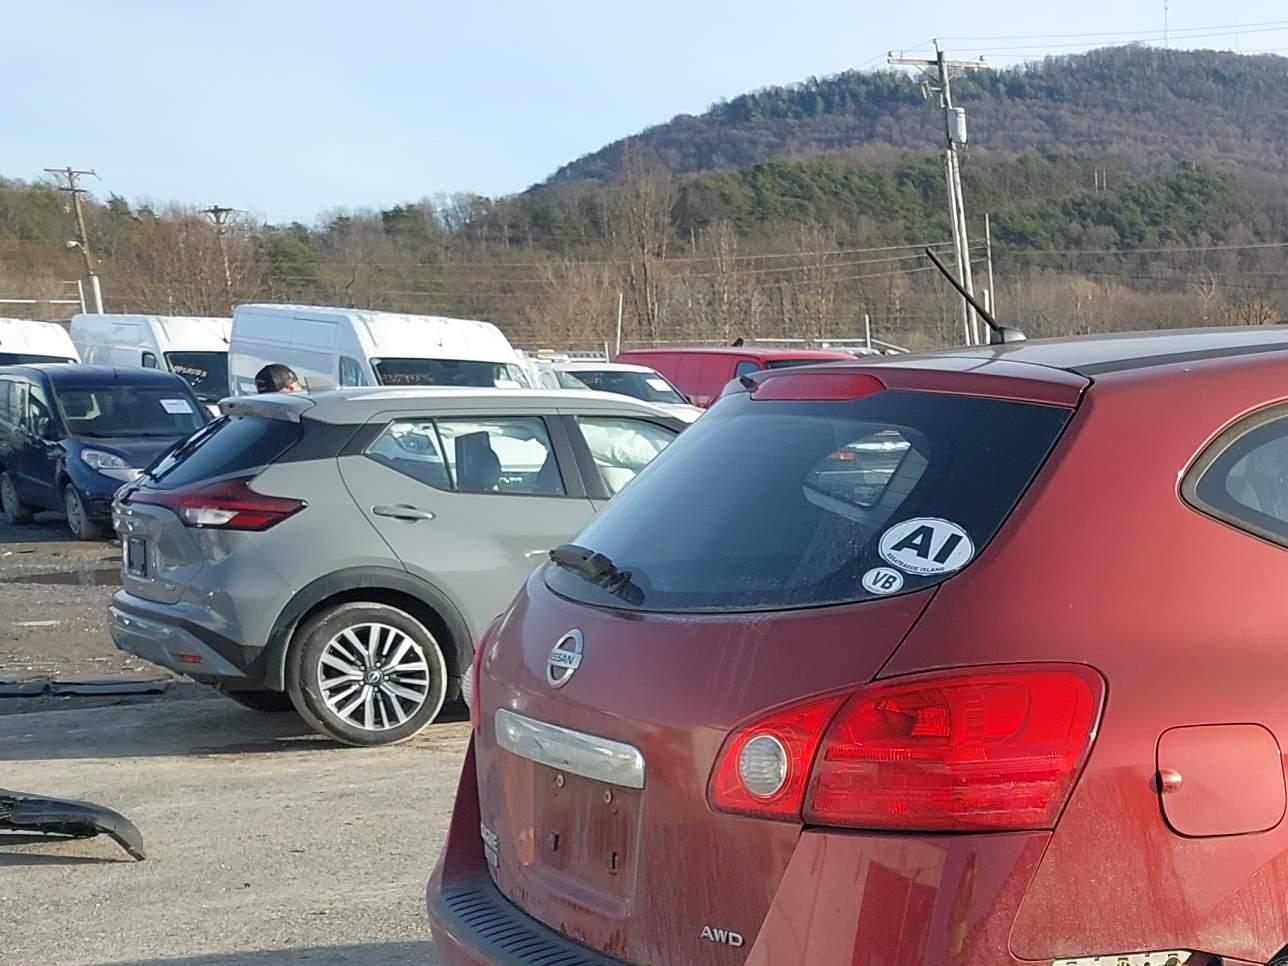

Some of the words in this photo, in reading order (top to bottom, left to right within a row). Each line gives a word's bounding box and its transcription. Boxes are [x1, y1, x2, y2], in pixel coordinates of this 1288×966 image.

[890, 524, 963, 565] AI
[872, 571, 898, 590] VB
[549, 652, 575, 666] SSAN
[700, 925, 744, 947] AWD
